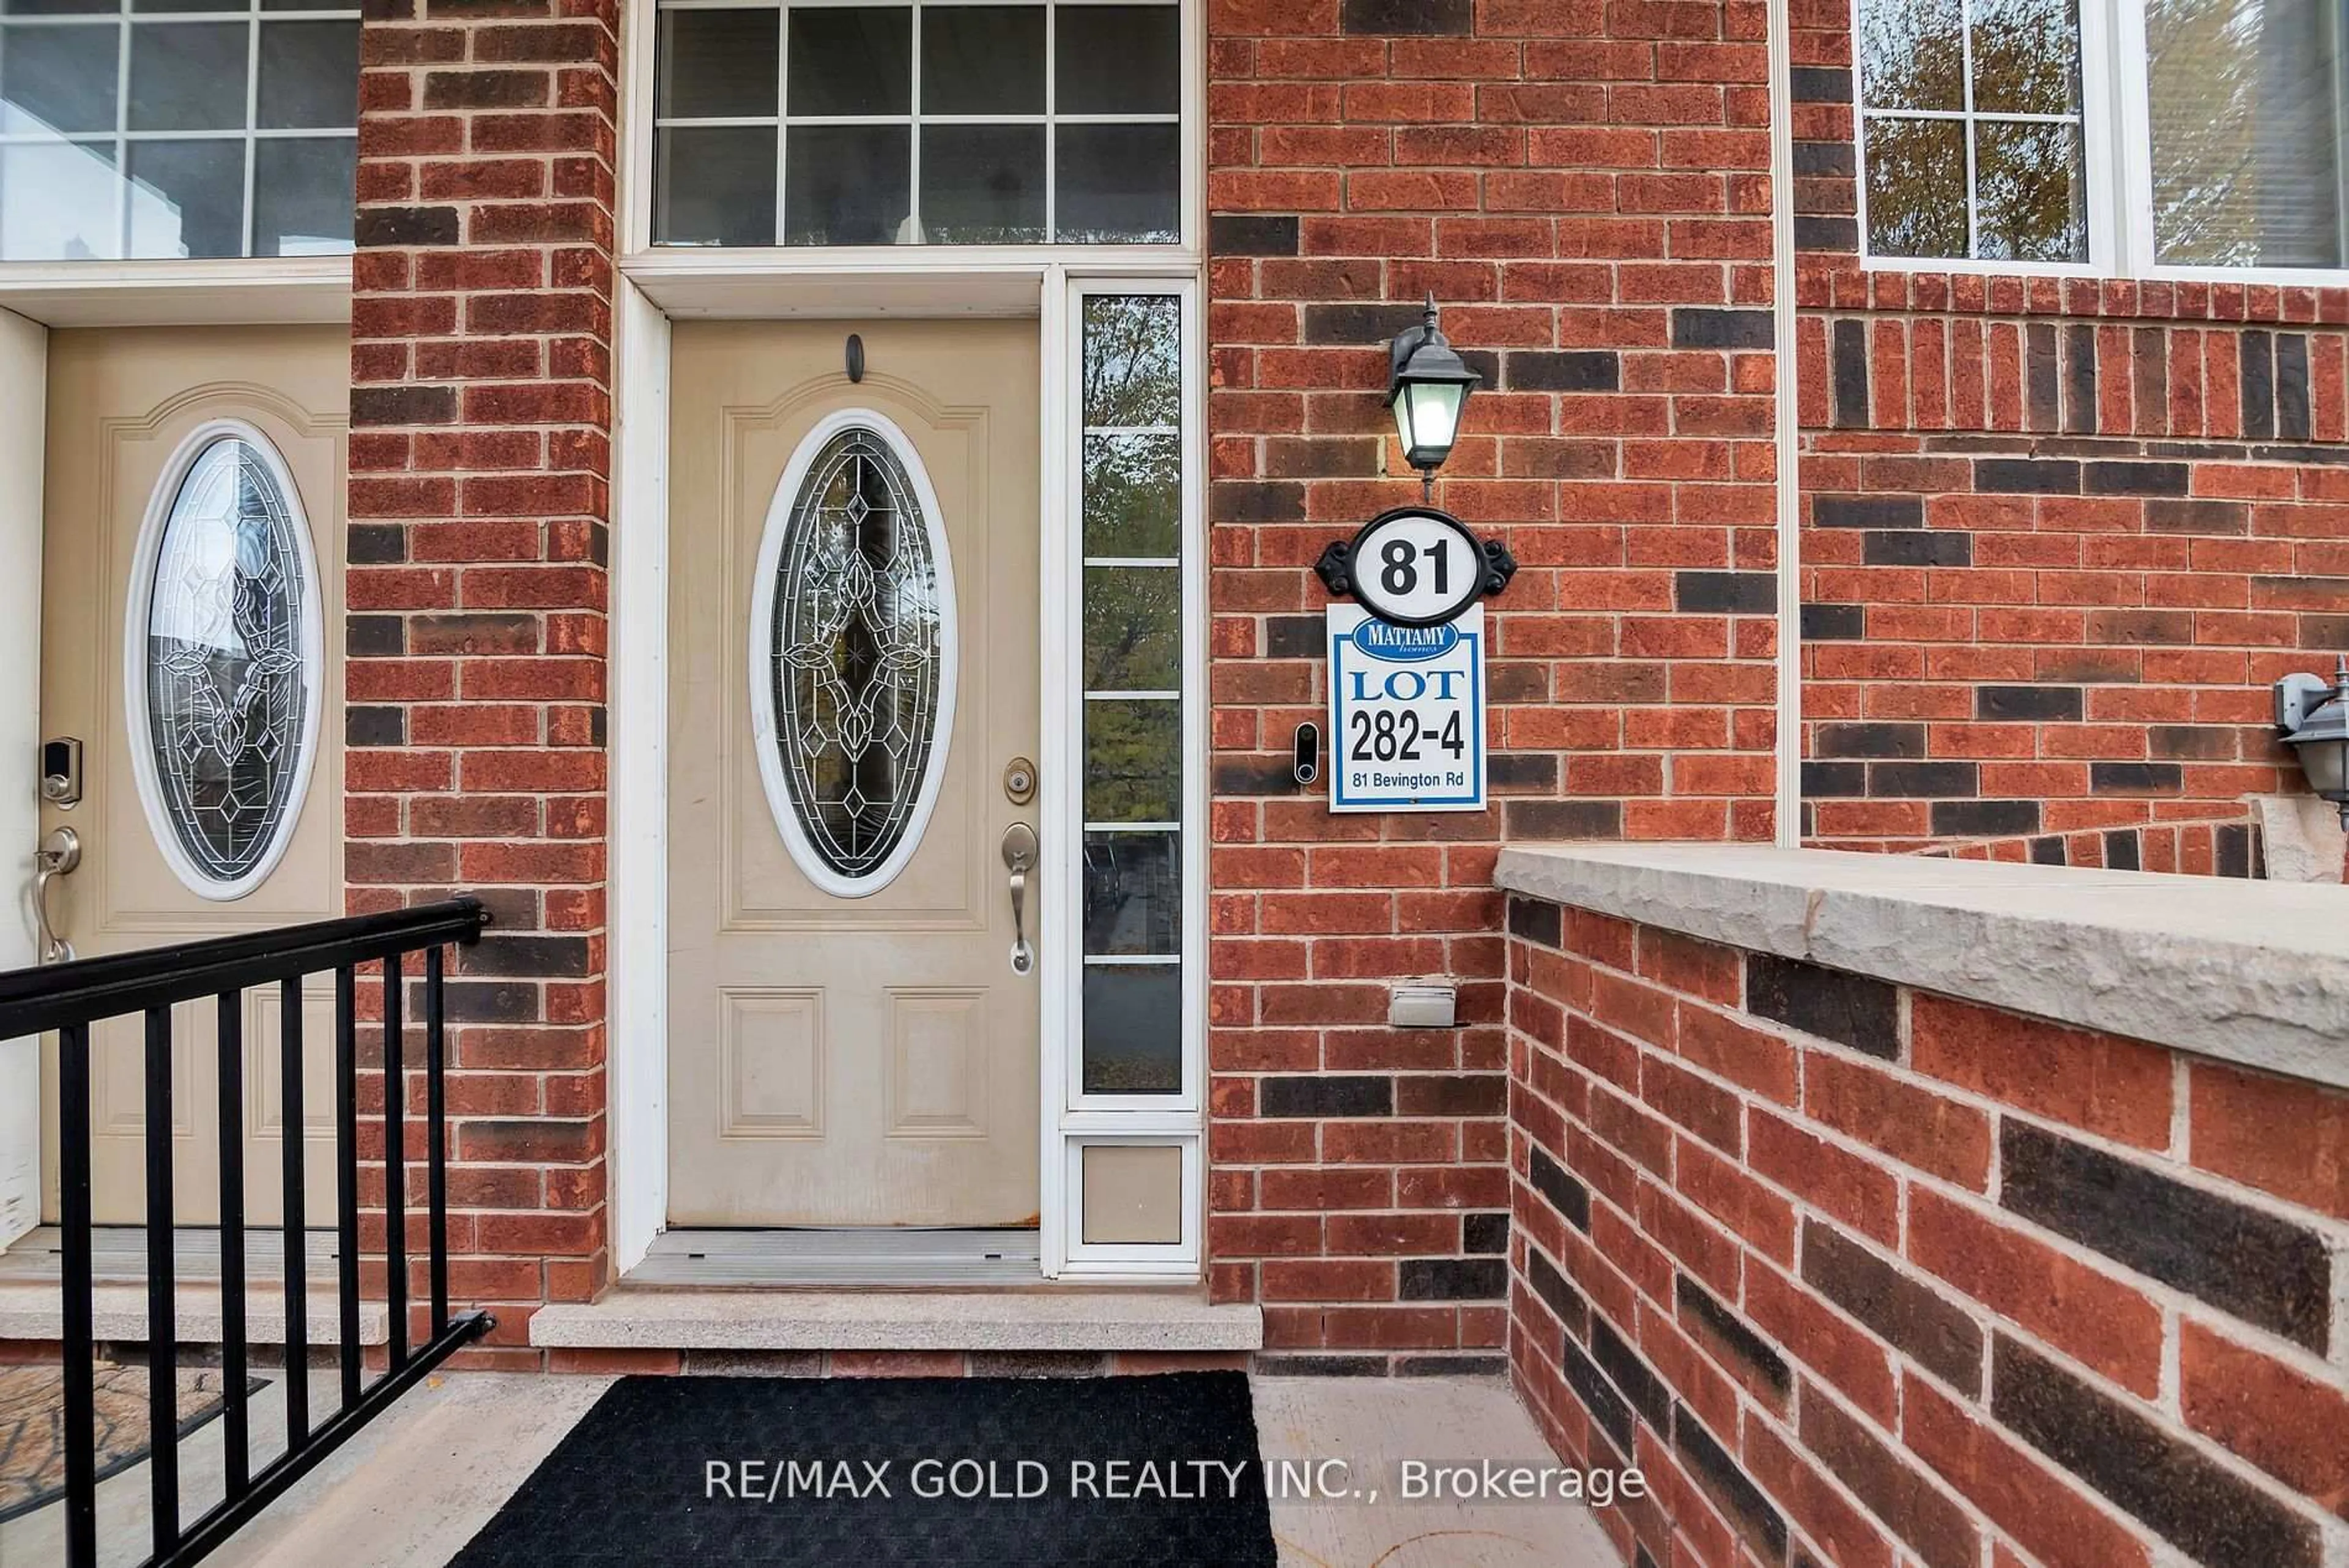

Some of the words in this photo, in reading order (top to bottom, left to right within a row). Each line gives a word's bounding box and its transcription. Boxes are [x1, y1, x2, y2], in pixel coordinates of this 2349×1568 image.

[1381, 539, 1448, 596] 81
[1368, 625, 1447, 646] MATTAMY
[1348, 671, 1465, 701] LOT
[1351, 709, 1464, 762] 282-4
[1353, 772, 1368, 787] 81
[1373, 772, 1441, 790] Bevington
[1446, 771, 1464, 786] Rd
